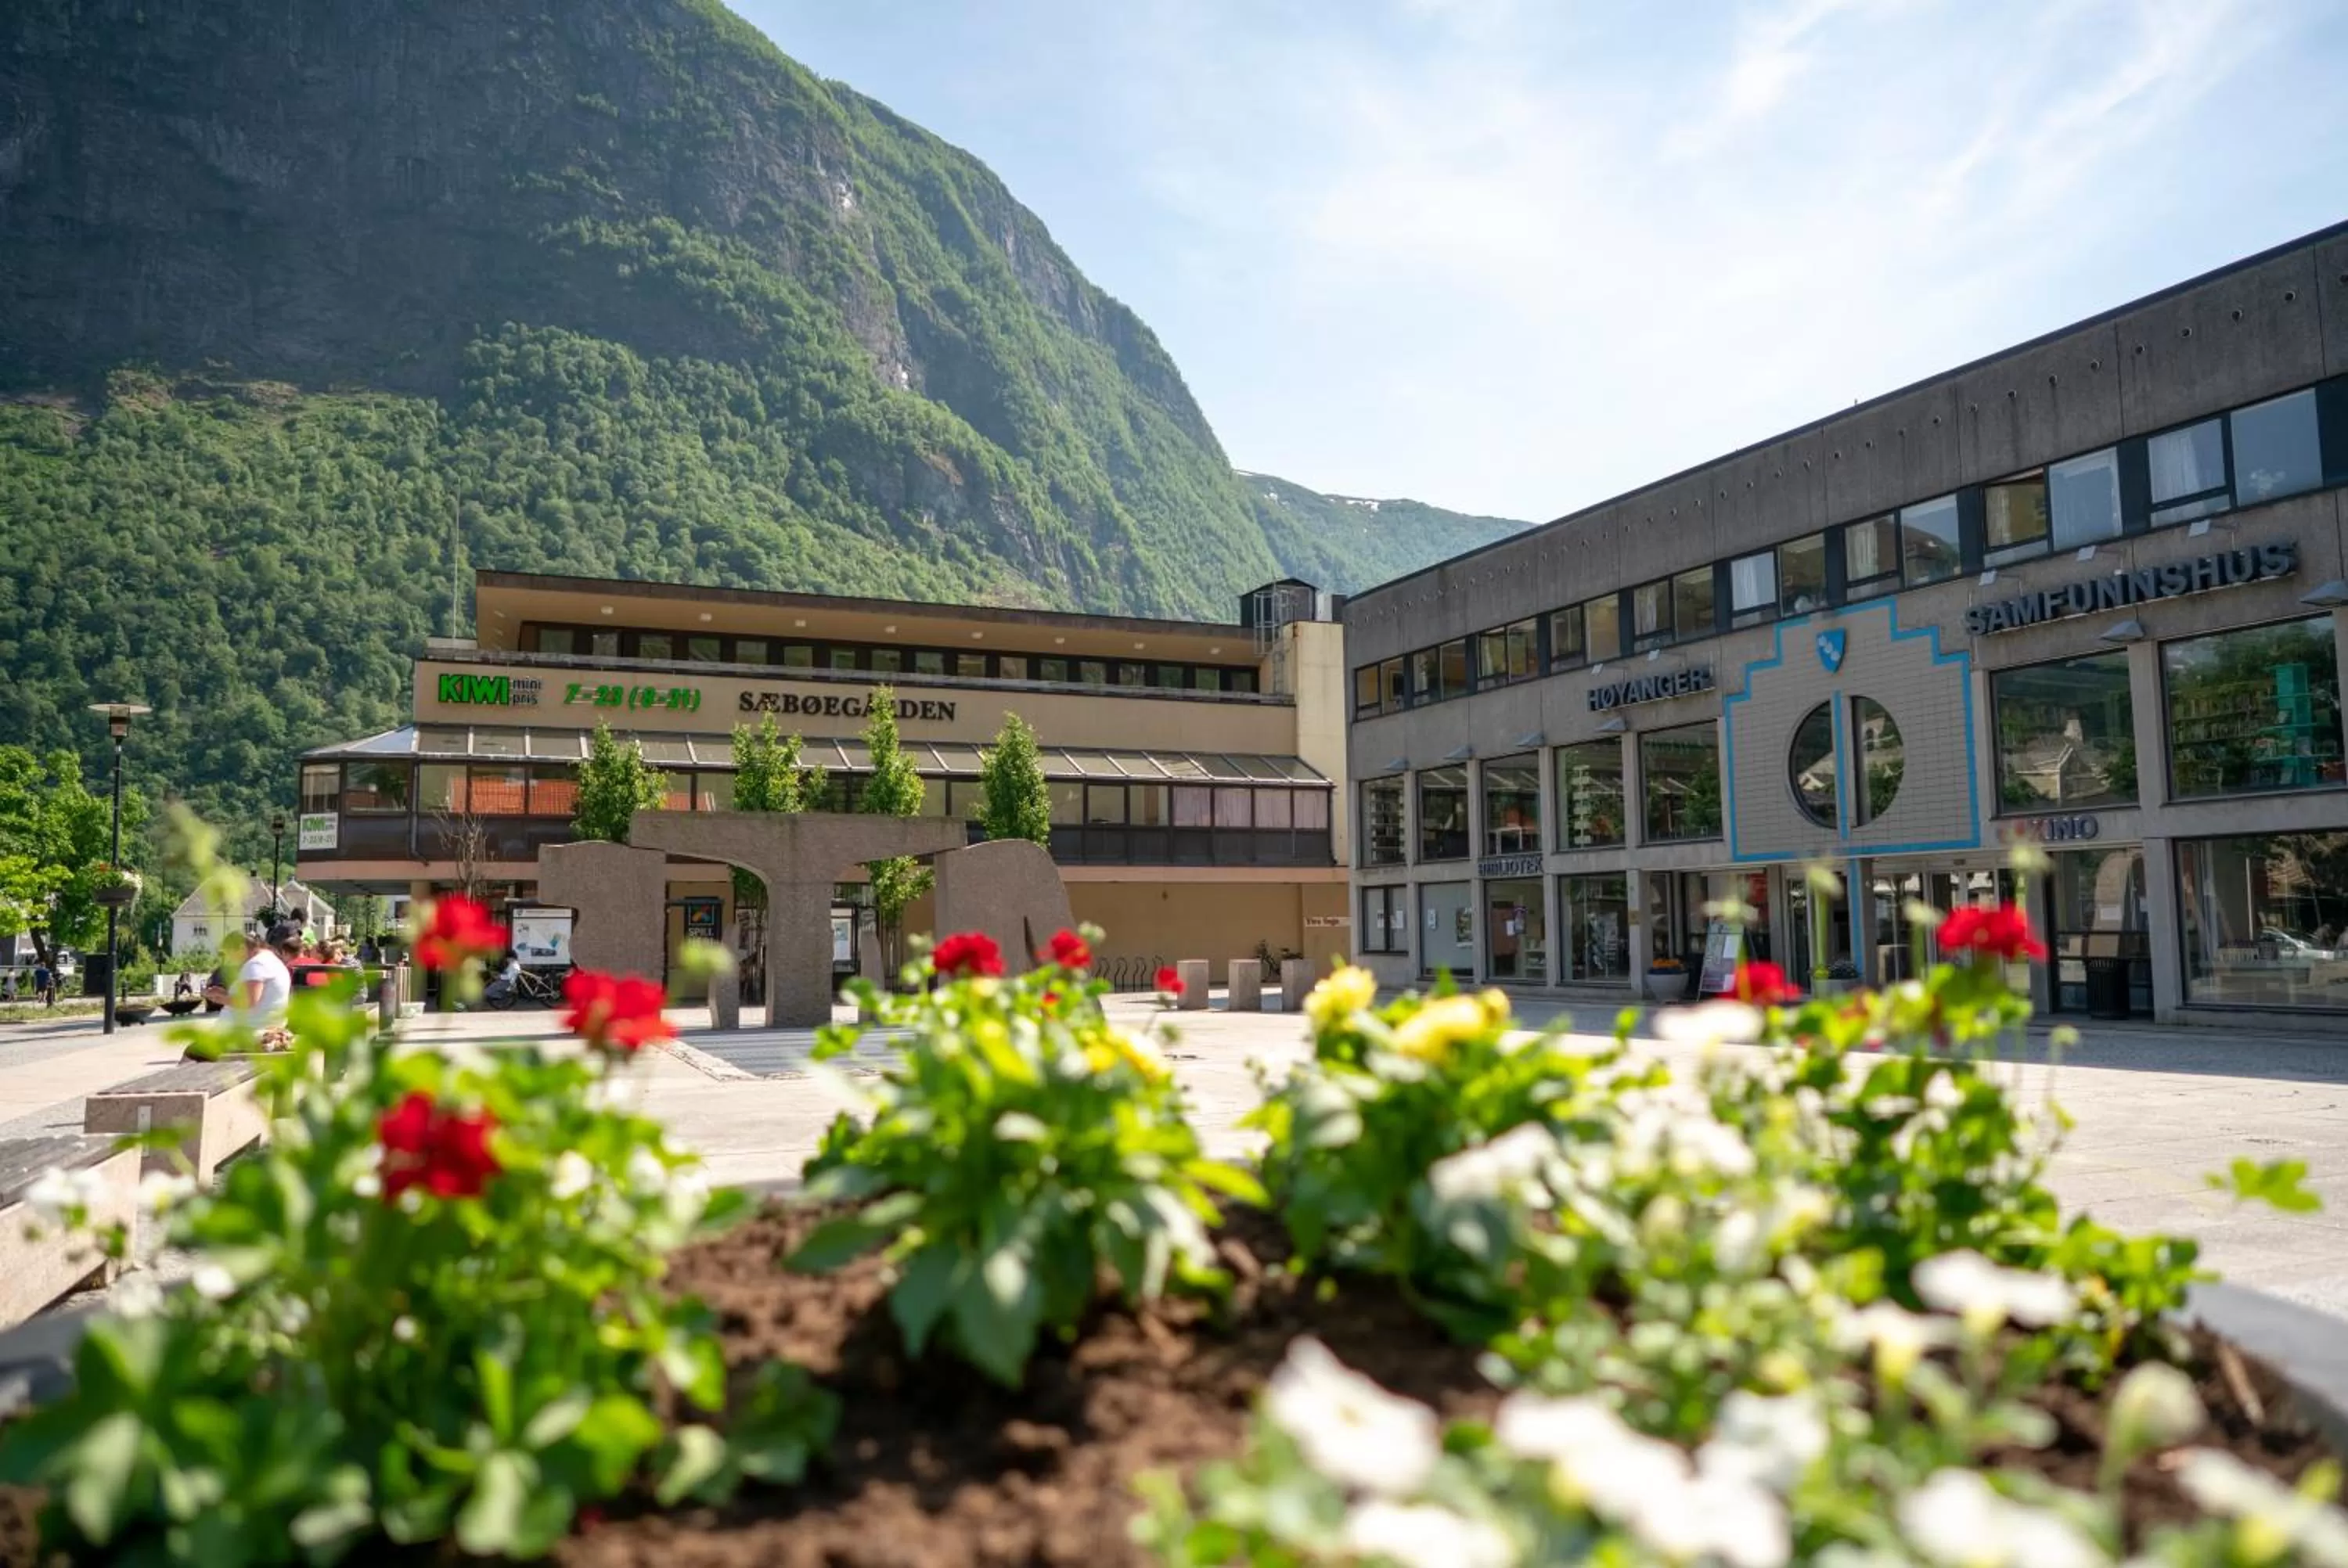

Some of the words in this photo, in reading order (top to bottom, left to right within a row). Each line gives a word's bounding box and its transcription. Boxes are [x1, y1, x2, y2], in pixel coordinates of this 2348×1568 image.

[1964, 541, 2298, 636] SAMFUNNSHUS
[438, 674, 510, 705] KIWI
[1586, 667, 1710, 711] HØYANGER
